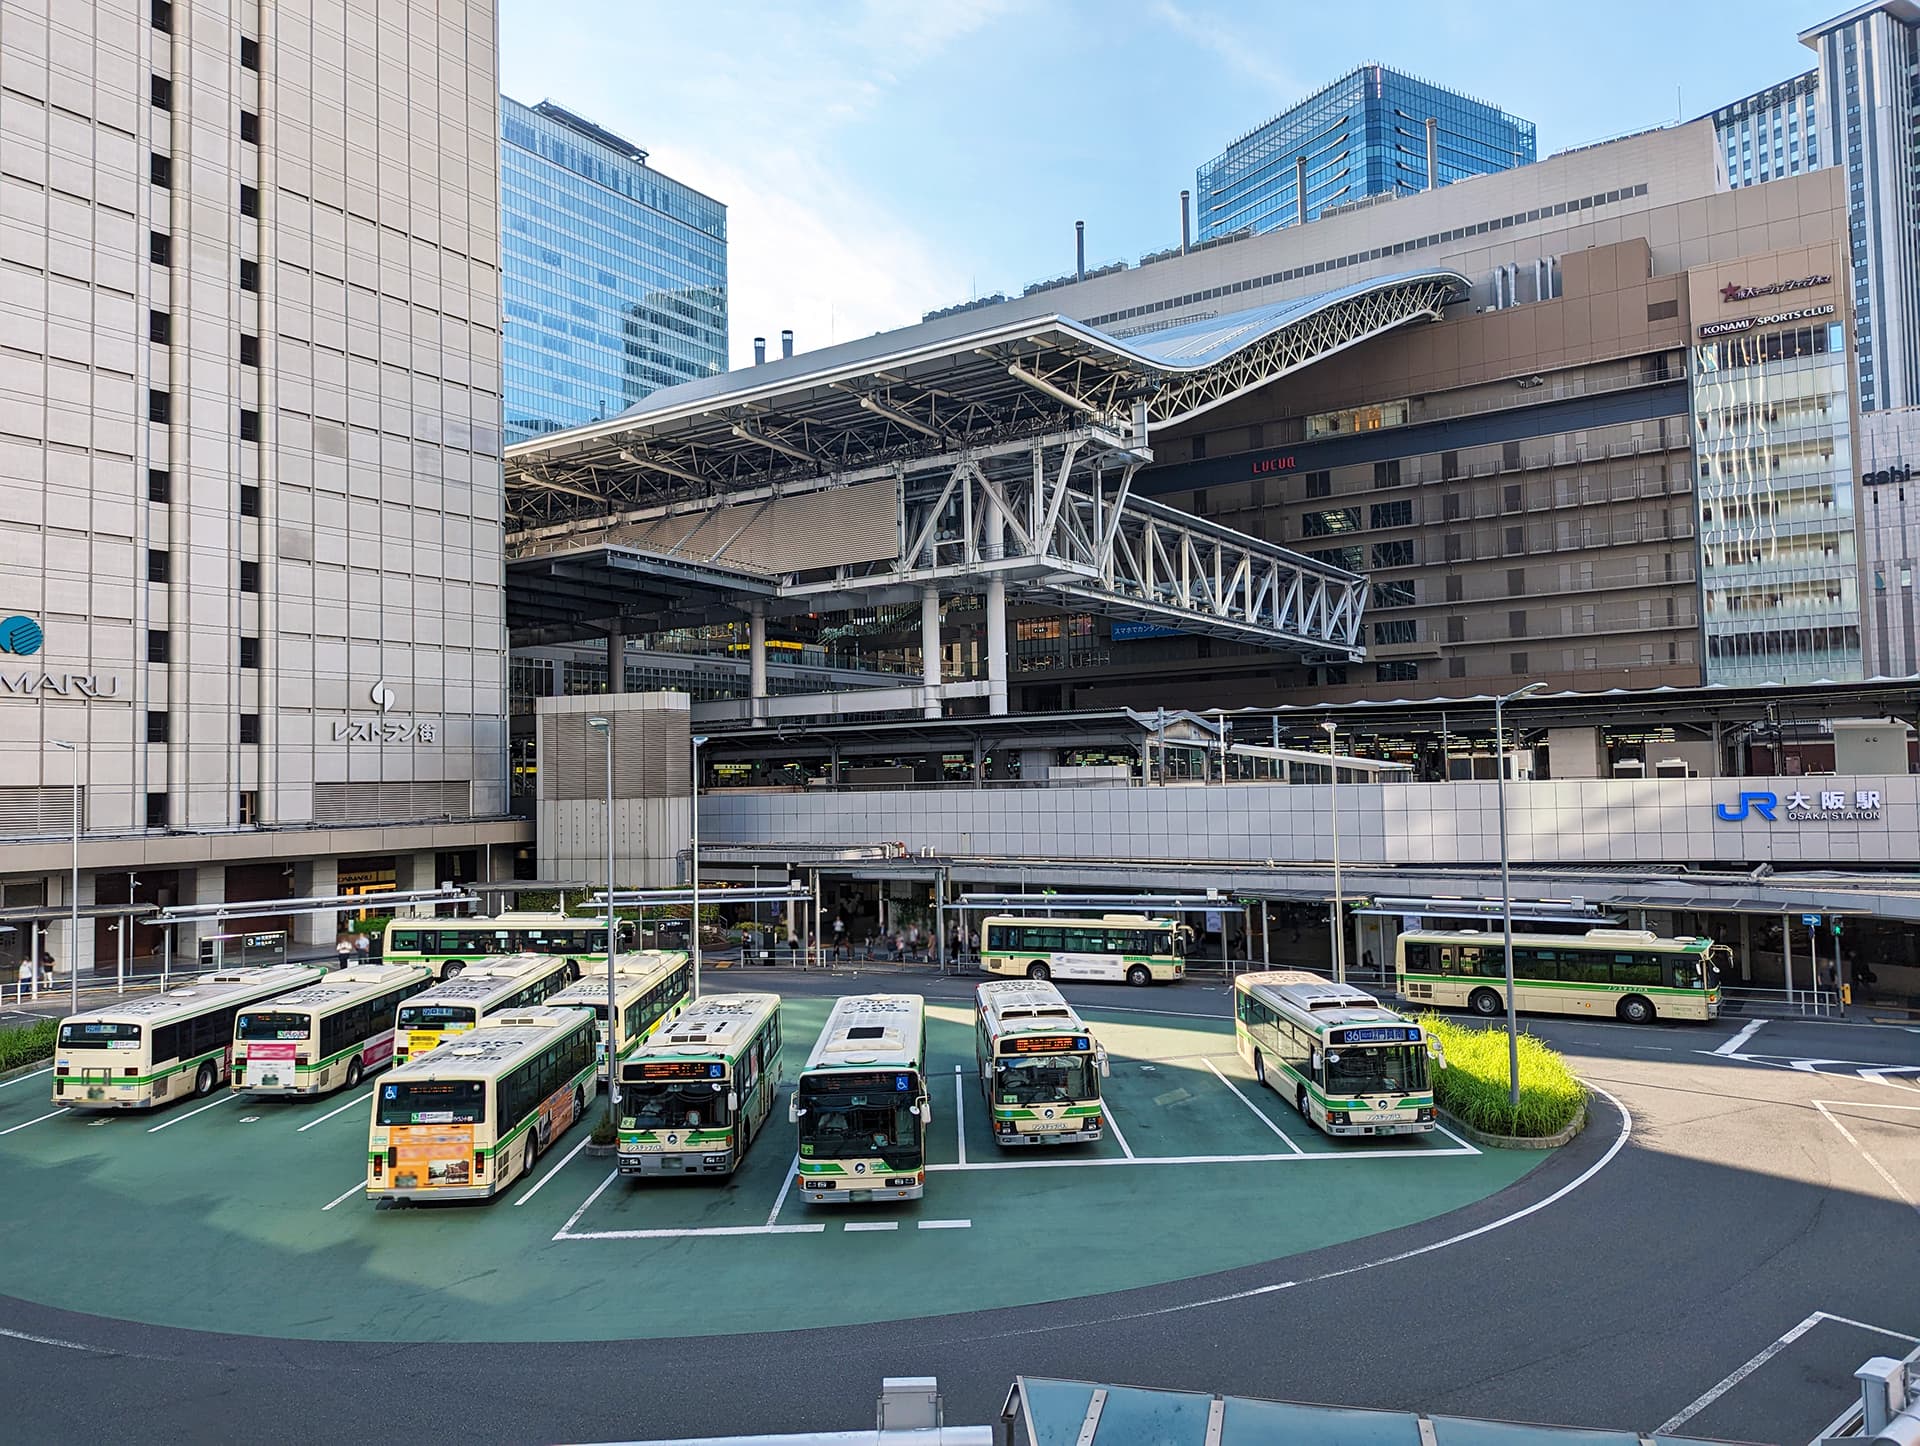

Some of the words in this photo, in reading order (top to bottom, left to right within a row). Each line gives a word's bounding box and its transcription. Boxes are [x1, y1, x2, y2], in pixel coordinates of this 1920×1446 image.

[1703, 320, 1749, 335] KONAMI
[1757, 310, 1801, 326] SPORTS
[1803, 304, 1835, 318] CLUB
[332, 721, 438, 743] レストラン街
[1717, 791, 1778, 821] JR
[1786, 790, 1881, 810] 大阪駅
[1788, 811, 1828, 821] OSAKA
[1831, 811, 1881, 821] STATION
[247, 938, 254, 946] 3
[1345, 1030, 1360, 1041] 36
